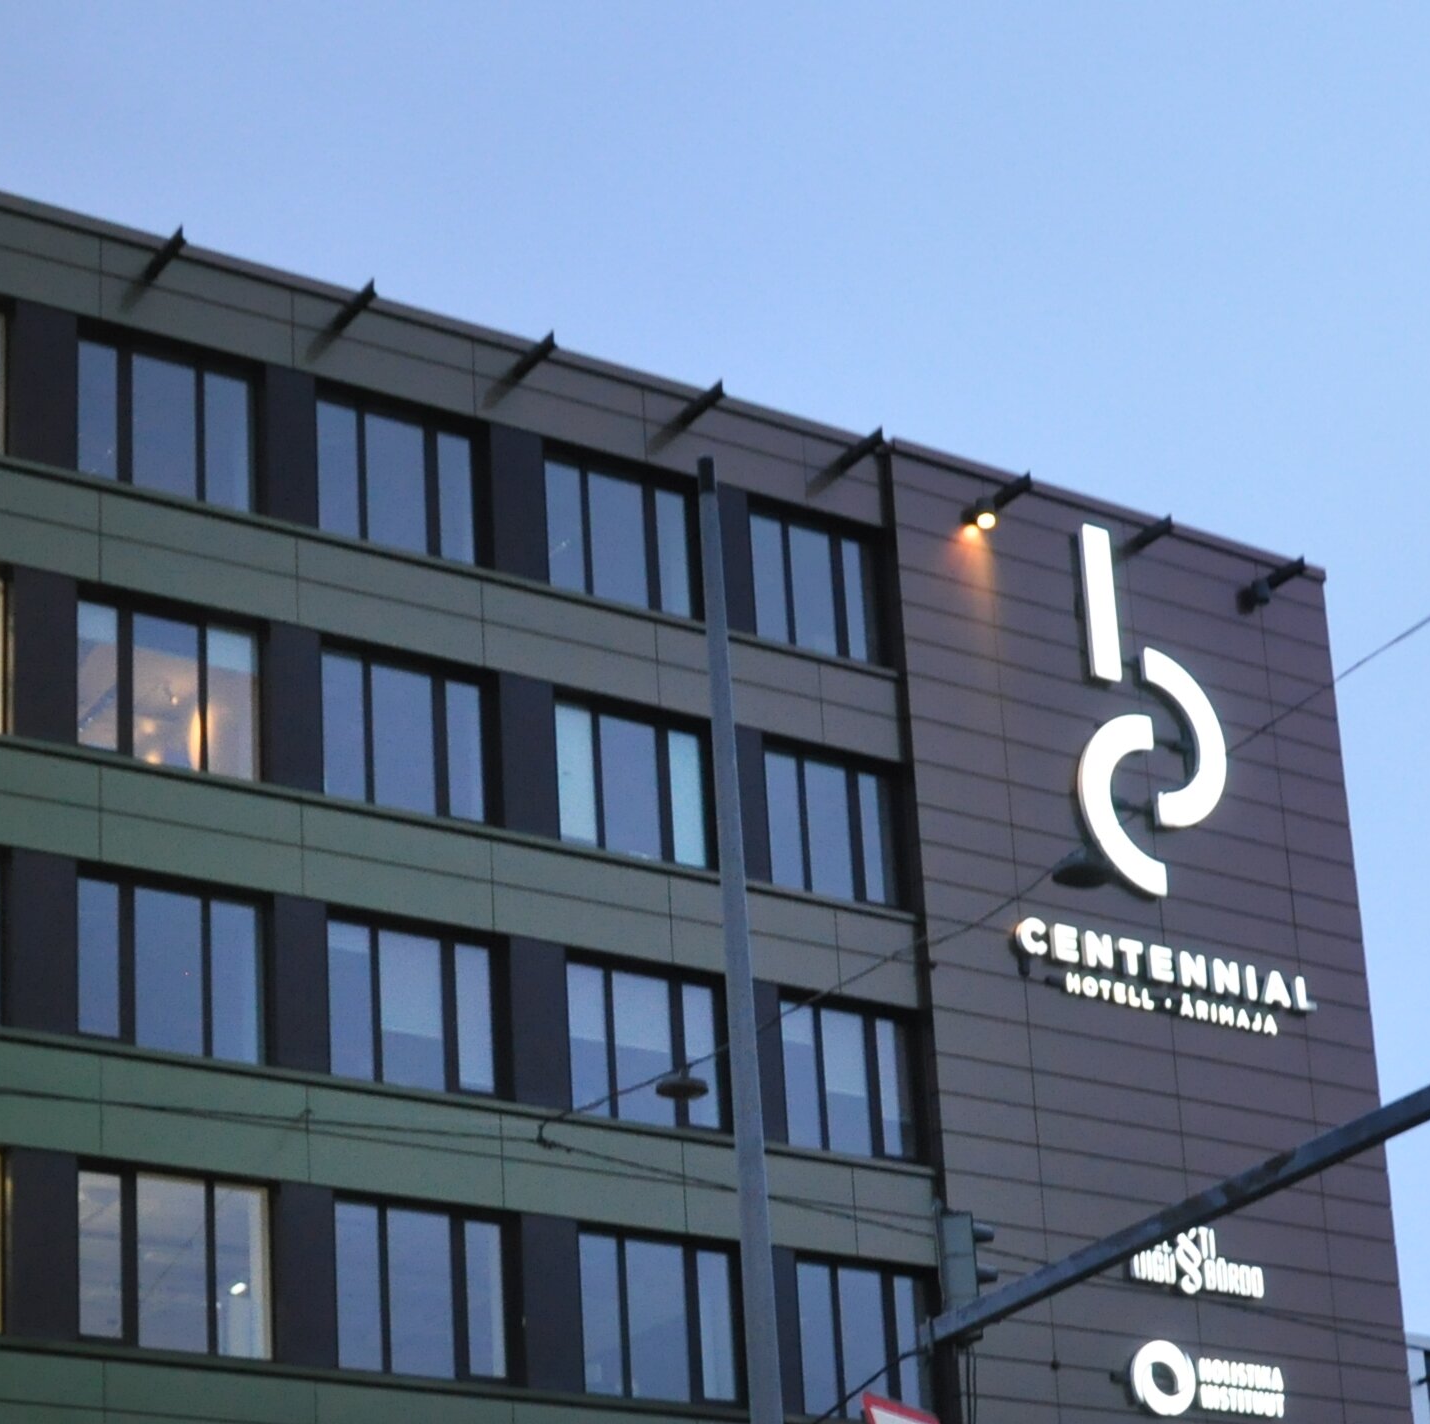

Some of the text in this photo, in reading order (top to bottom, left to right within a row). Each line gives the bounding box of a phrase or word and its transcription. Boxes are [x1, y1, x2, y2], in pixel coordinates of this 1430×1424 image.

[1016, 917, 1317, 1011] CENTENNIAL
[1065, 972, 1278, 1036] HOTELL ÄRIMAJA
